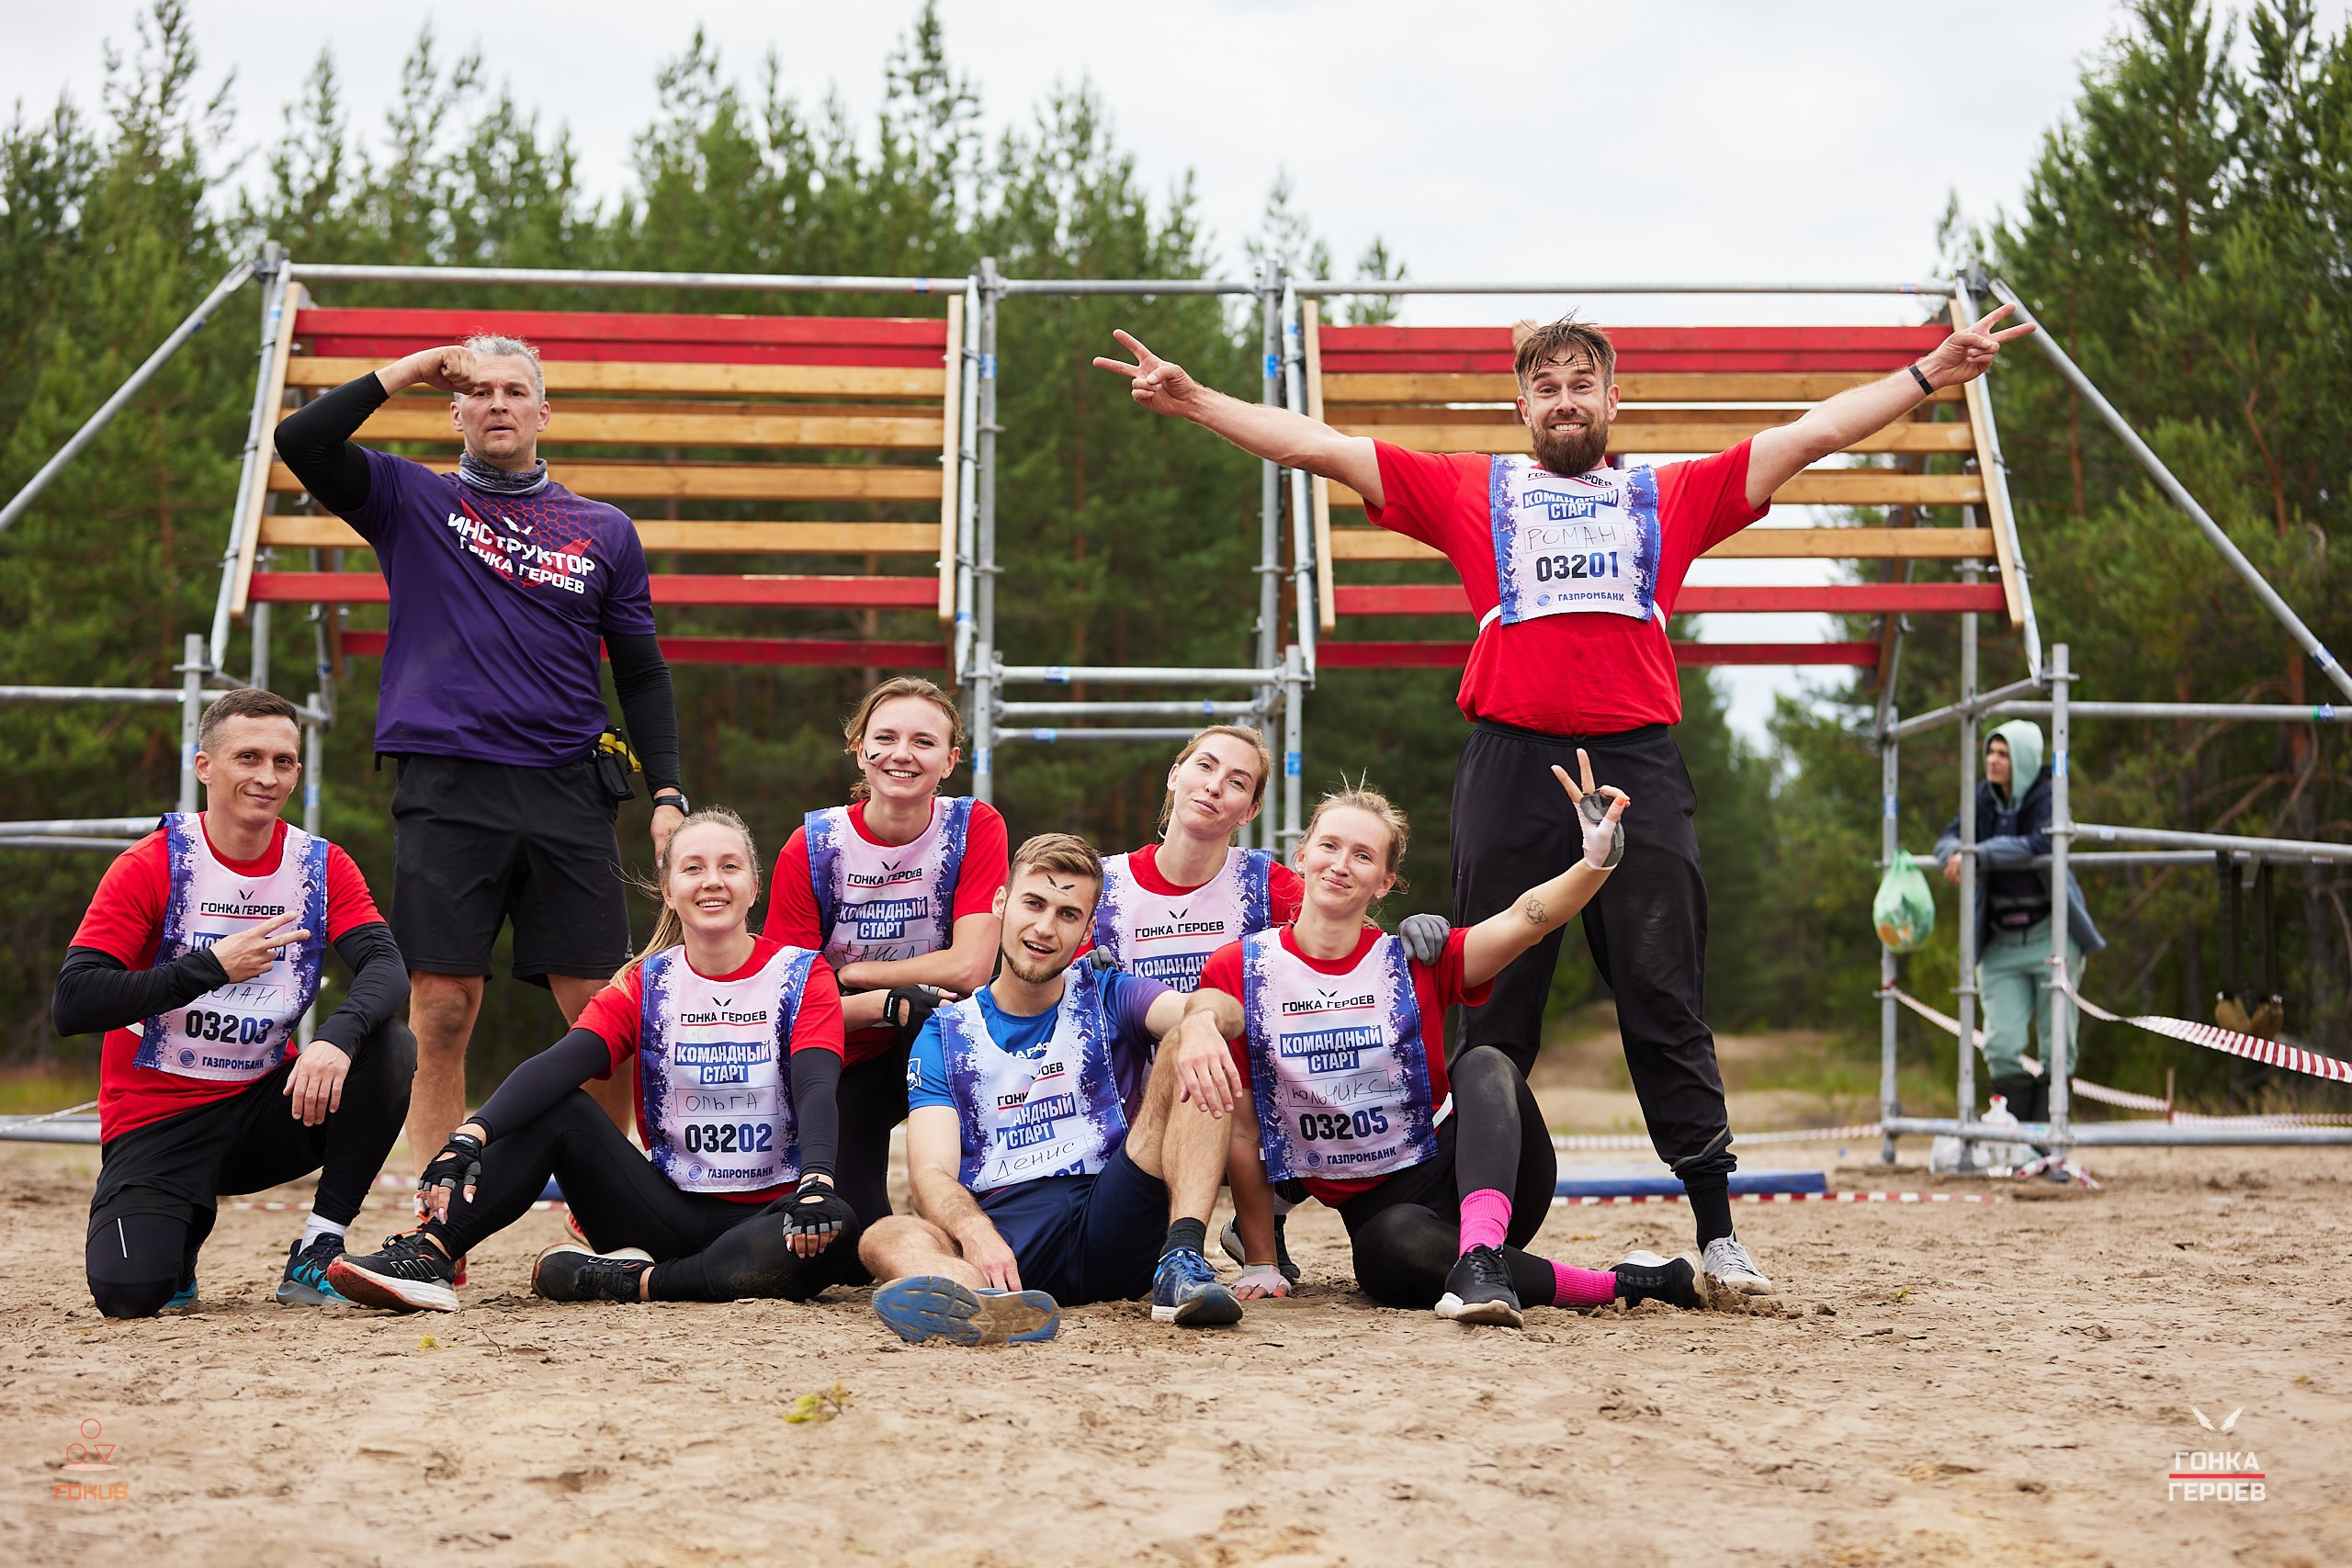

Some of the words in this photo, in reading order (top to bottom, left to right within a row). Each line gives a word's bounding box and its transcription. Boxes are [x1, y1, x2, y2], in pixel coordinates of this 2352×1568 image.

[1550, 502, 1594, 519] СТАРТ
[447, 513, 595, 576] ИНСТРУКТОР
[1527, 525, 1617, 550] РОМАН
[1535, 551, 1619, 581] 03201
[518, 563, 585, 594] ГЕРОЕВ
[1557, 592, 1625, 602] ГАЗПРОМБАНК
[847, 873, 884, 885] ГОНКА
[886, 868, 922, 883] ГЕРОЕВ
[200, 902, 240, 915] ГОНКА
[241, 904, 286, 916] ГЕРОЕВ
[840, 897, 927, 922] КОМАНДНЫЙ
[860, 920, 902, 938] СТАРТ
[1135, 924, 1173, 938] ГОНКА
[1177, 920, 1225, 933] ГЕРОЕВ
[1134, 953, 1210, 977] КОМАНДН
[198, 986, 277, 1006] СЛАН
[1282, 999, 1323, 1012] ГОНКА
[1327, 994, 1375, 1009] ГЕРОЕВ
[185, 1010, 274, 1044] 03203
[680, 1012, 717, 1023] ГОНКА
[721, 1010, 767, 1022] ГЕРОЕВ
[1281, 1025, 1381, 1054] КОМАНДНЫЙ
[202, 1055, 265, 1069] ГАЗПРОМБАНК
[676, 1040, 770, 1064] КОМАНДНЫЙ
[1310, 1050, 1356, 1071] СТАРТ
[702, 1065, 746, 1083] СТАРТ
[685, 1091, 760, 1112] ОЛЬГА
[997, 1091, 1029, 1107] ГОНК
[1012, 1091, 1075, 1127] АНДНЫЙ
[1298, 1106, 1389, 1141] 03205
[684, 1122, 773, 1153] 03202
[1008, 1122, 1051, 1147] СТАРТ
[1327, 1145, 1396, 1165] ГАЗПРОМБАНК
[707, 1165, 774, 1179] ГАЗПРОМБАНК
